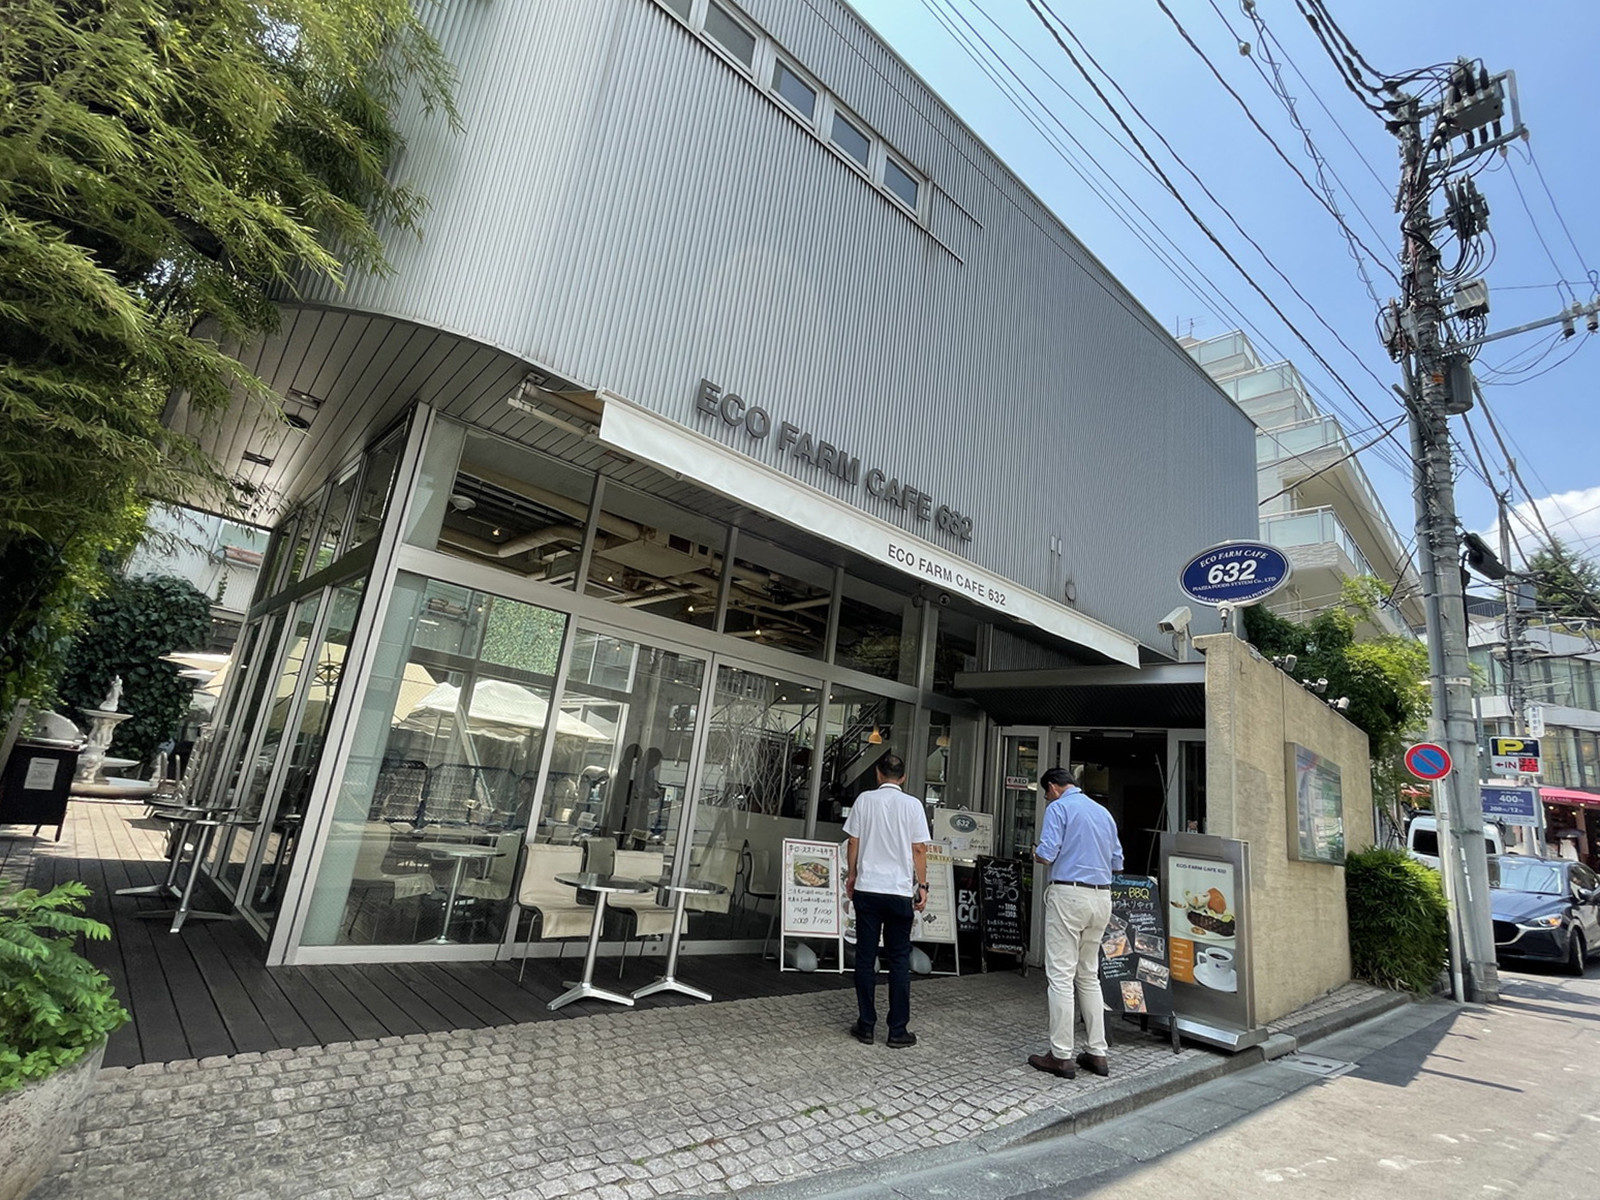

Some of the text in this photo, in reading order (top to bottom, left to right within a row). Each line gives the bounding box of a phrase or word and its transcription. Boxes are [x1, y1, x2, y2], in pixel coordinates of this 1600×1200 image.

[697, 378, 974, 542] ECO FARM CAFE 632
[1200, 549, 1269, 568] ECO FARM CAFE
[888, 543, 1006, 606] ECO FARM CAFE 632
[1207, 559, 1258, 585] 632
[1497, 739, 1525, 756] P
[1504, 761, 1517, 769] IN
[1128, 887, 1150, 900] BBQ
